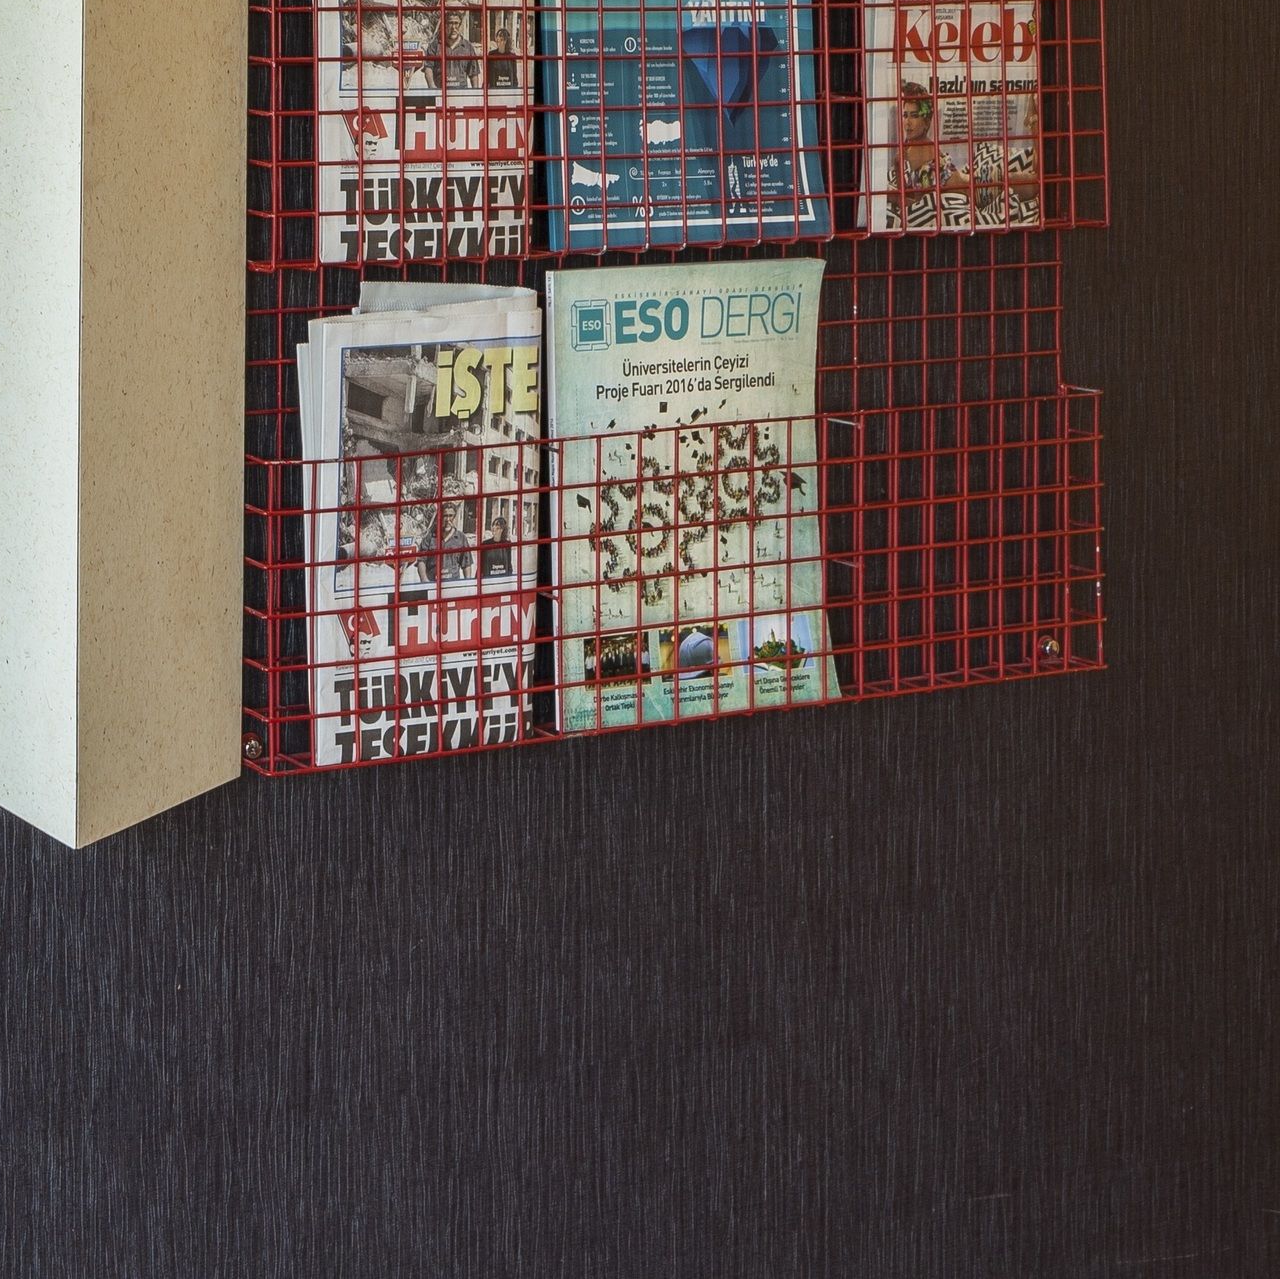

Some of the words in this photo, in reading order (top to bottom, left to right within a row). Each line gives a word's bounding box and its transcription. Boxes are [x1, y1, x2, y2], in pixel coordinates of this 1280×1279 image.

[742, 154, 779, 170] Türkye'de
[582, 319, 602, 331] ESO
[614, 297, 690, 345] ESO
[622, 358, 711, 377] Üniversitelerin
[714, 353, 749, 374] Çeyizi
[596, 383, 629, 402] Proje
[632, 381, 662, 397] Fuarı
[666, 376, 712, 394] 2016'da
[714, 372, 775, 394] Sergilendi
